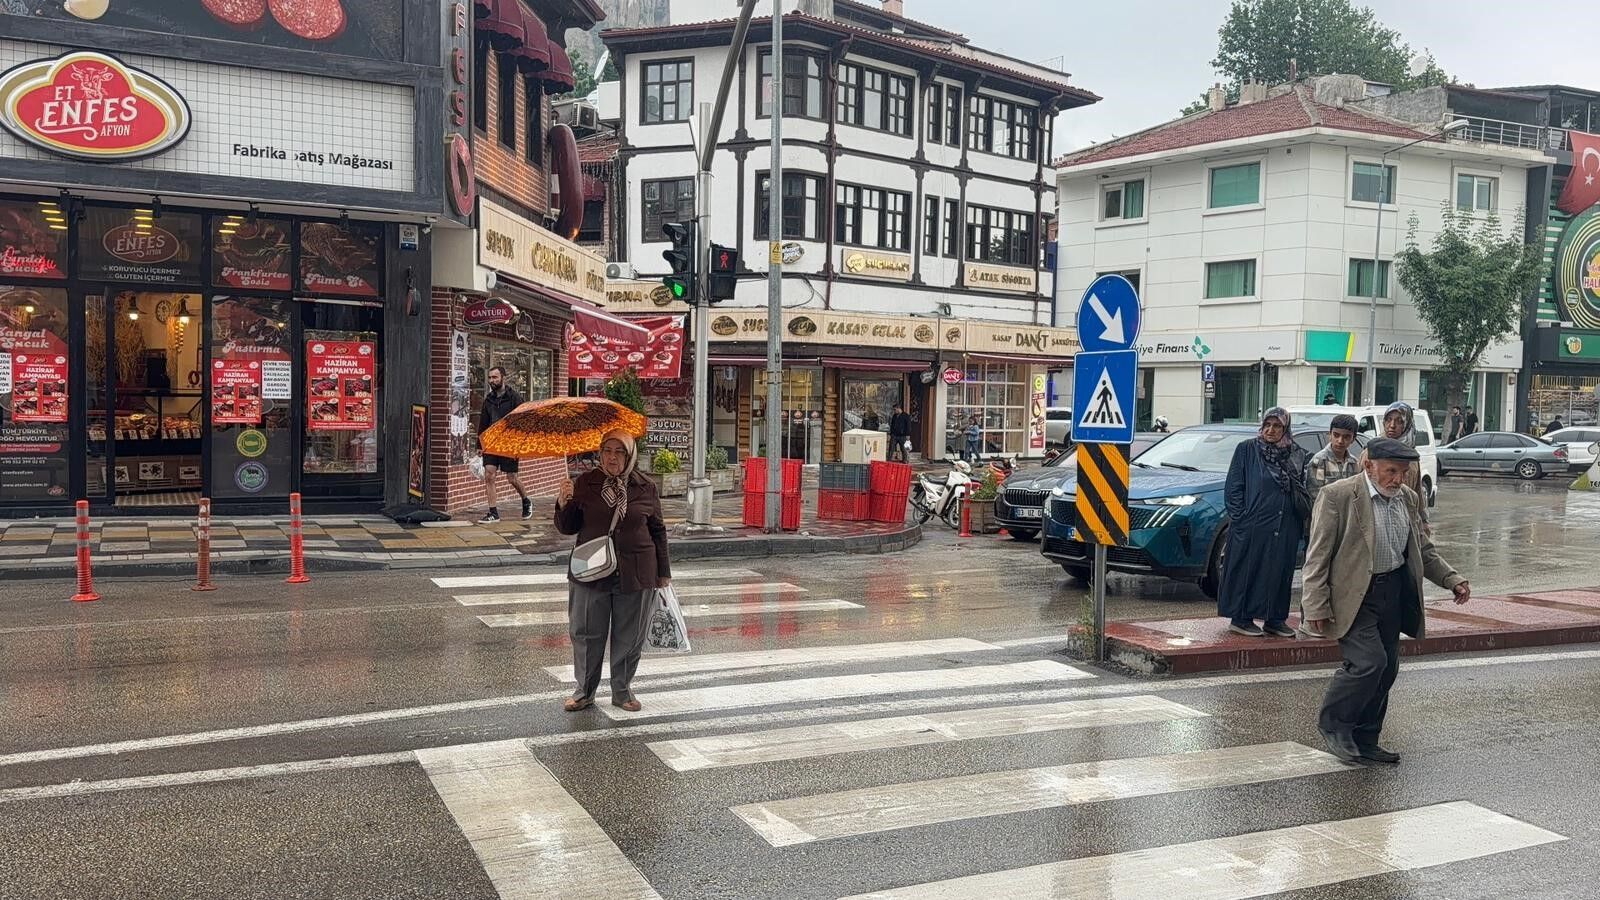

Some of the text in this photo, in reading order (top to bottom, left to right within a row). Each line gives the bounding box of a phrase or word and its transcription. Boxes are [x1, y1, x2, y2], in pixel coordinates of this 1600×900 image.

[54, 86, 74, 101] ET
[42, 96, 139, 128] ENFES
[100, 124, 131, 137] AFYON
[233, 143, 287, 162] Fabrika
[328, 151, 394, 171] Mağazası
[116, 235, 166, 252] ENFES
[109, 265, 181, 275] KORUYUCU İÇERMEZ
[221, 267, 289, 279] Frankfurter
[114, 273, 176, 282] GLUTEN İÇERMEZ
[304, 273, 342, 286] Füme
[471, 308, 507, 317] CANTÜRK
[827, 321, 906, 338] KASAP CELAL
[2, 337, 49, 349] Sucuk
[222, 340, 280, 354] Pastırma
[1156, 343, 1189, 353] Finans
[1379, 343, 1412, 357] Türkiye
[324, 358, 358, 367] HAZİRAN
[317, 367, 366, 375] KAMPANYASI
[1205, 365, 1212, 378] P
